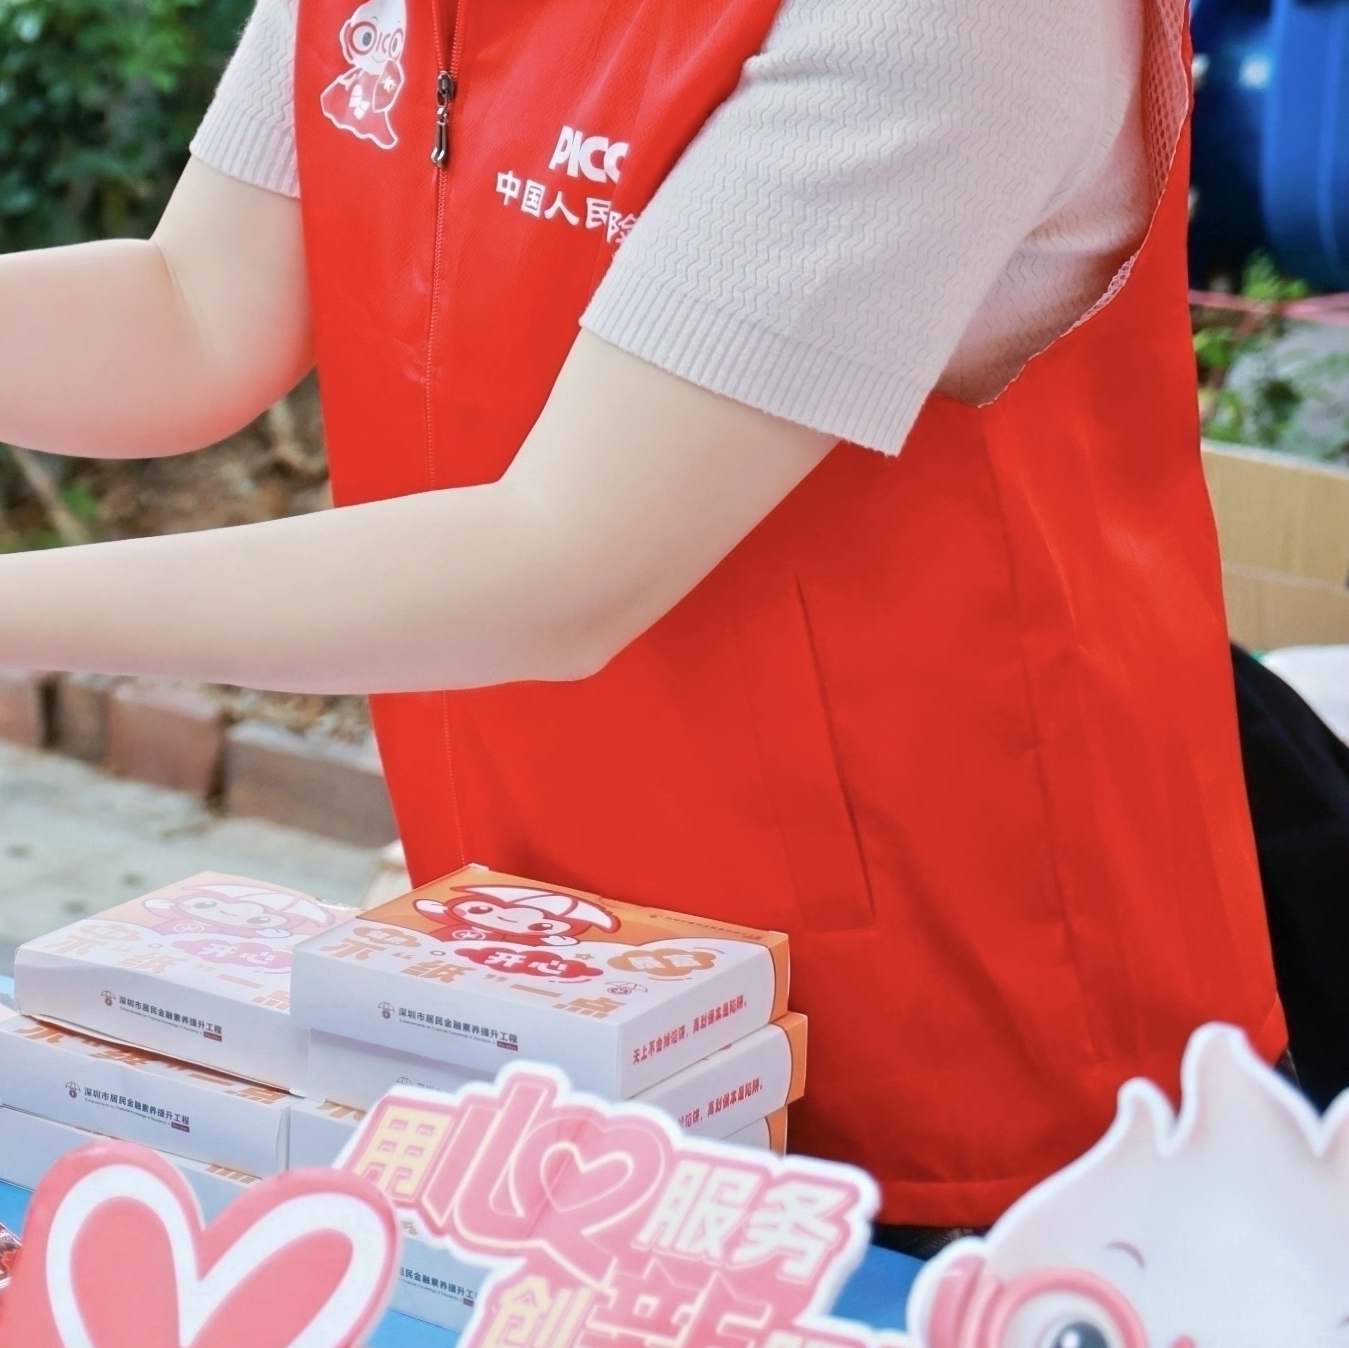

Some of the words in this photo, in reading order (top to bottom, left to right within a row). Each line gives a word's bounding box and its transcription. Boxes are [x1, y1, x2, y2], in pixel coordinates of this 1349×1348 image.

[548, 125, 629, 184] PICC
[487, 951, 567, 976] 开心
[119, 996, 222, 1034] 深圳市居民金融素养提升工程
[398, 1007, 518, 1044] 深圳市居民金融素养提升工程
[84, 1087, 190, 1125] 深圳市居民金融素养提升工程
[400, 1267, 477, 1299] 民金融素养提升工
